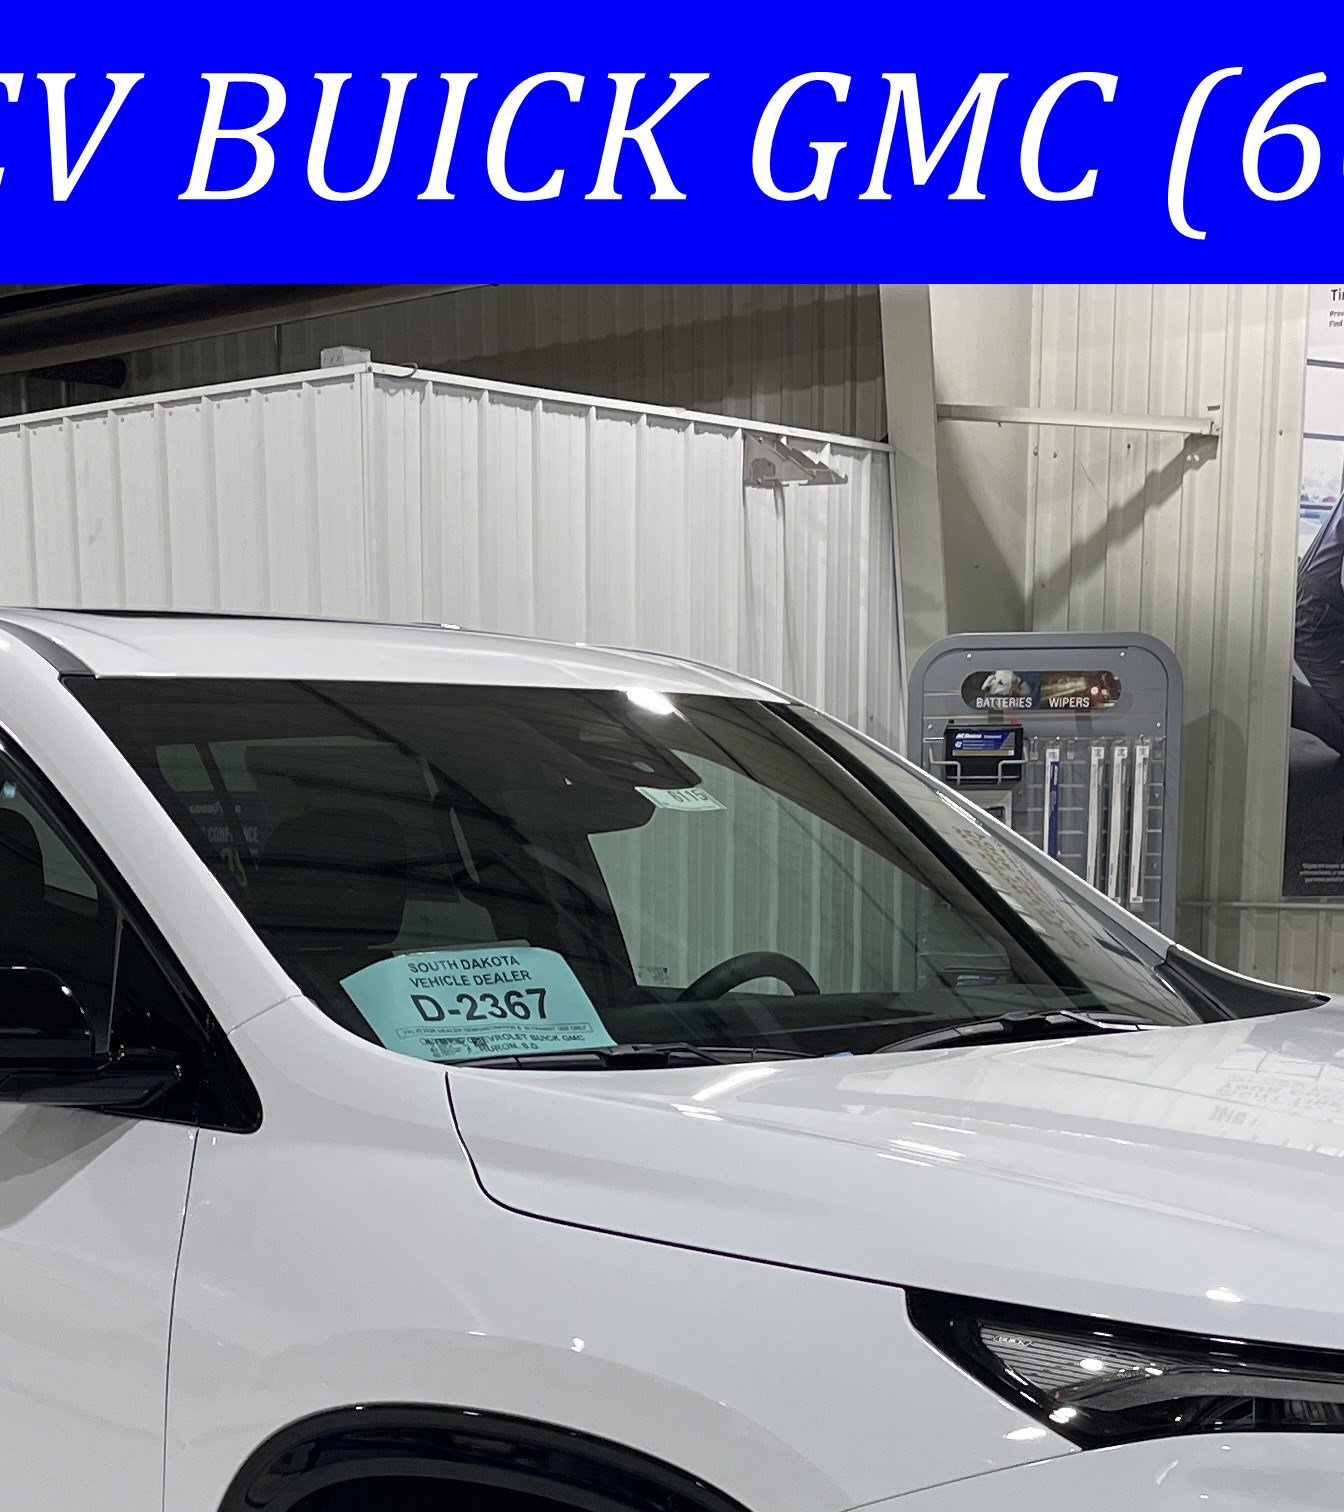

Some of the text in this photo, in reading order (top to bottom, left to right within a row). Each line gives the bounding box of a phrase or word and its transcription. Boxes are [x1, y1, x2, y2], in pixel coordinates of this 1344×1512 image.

[1329, 319, 1343, 327] Find
[976, 697, 1090, 709] BATTERIES WIPERS
[408, 956, 520, 973] SOUTH DAKOTA
[408, 970, 532, 988] VEHICLE DEALER
[410, 987, 547, 1023] D-2367
[562, 1034, 586, 1042] GMC
